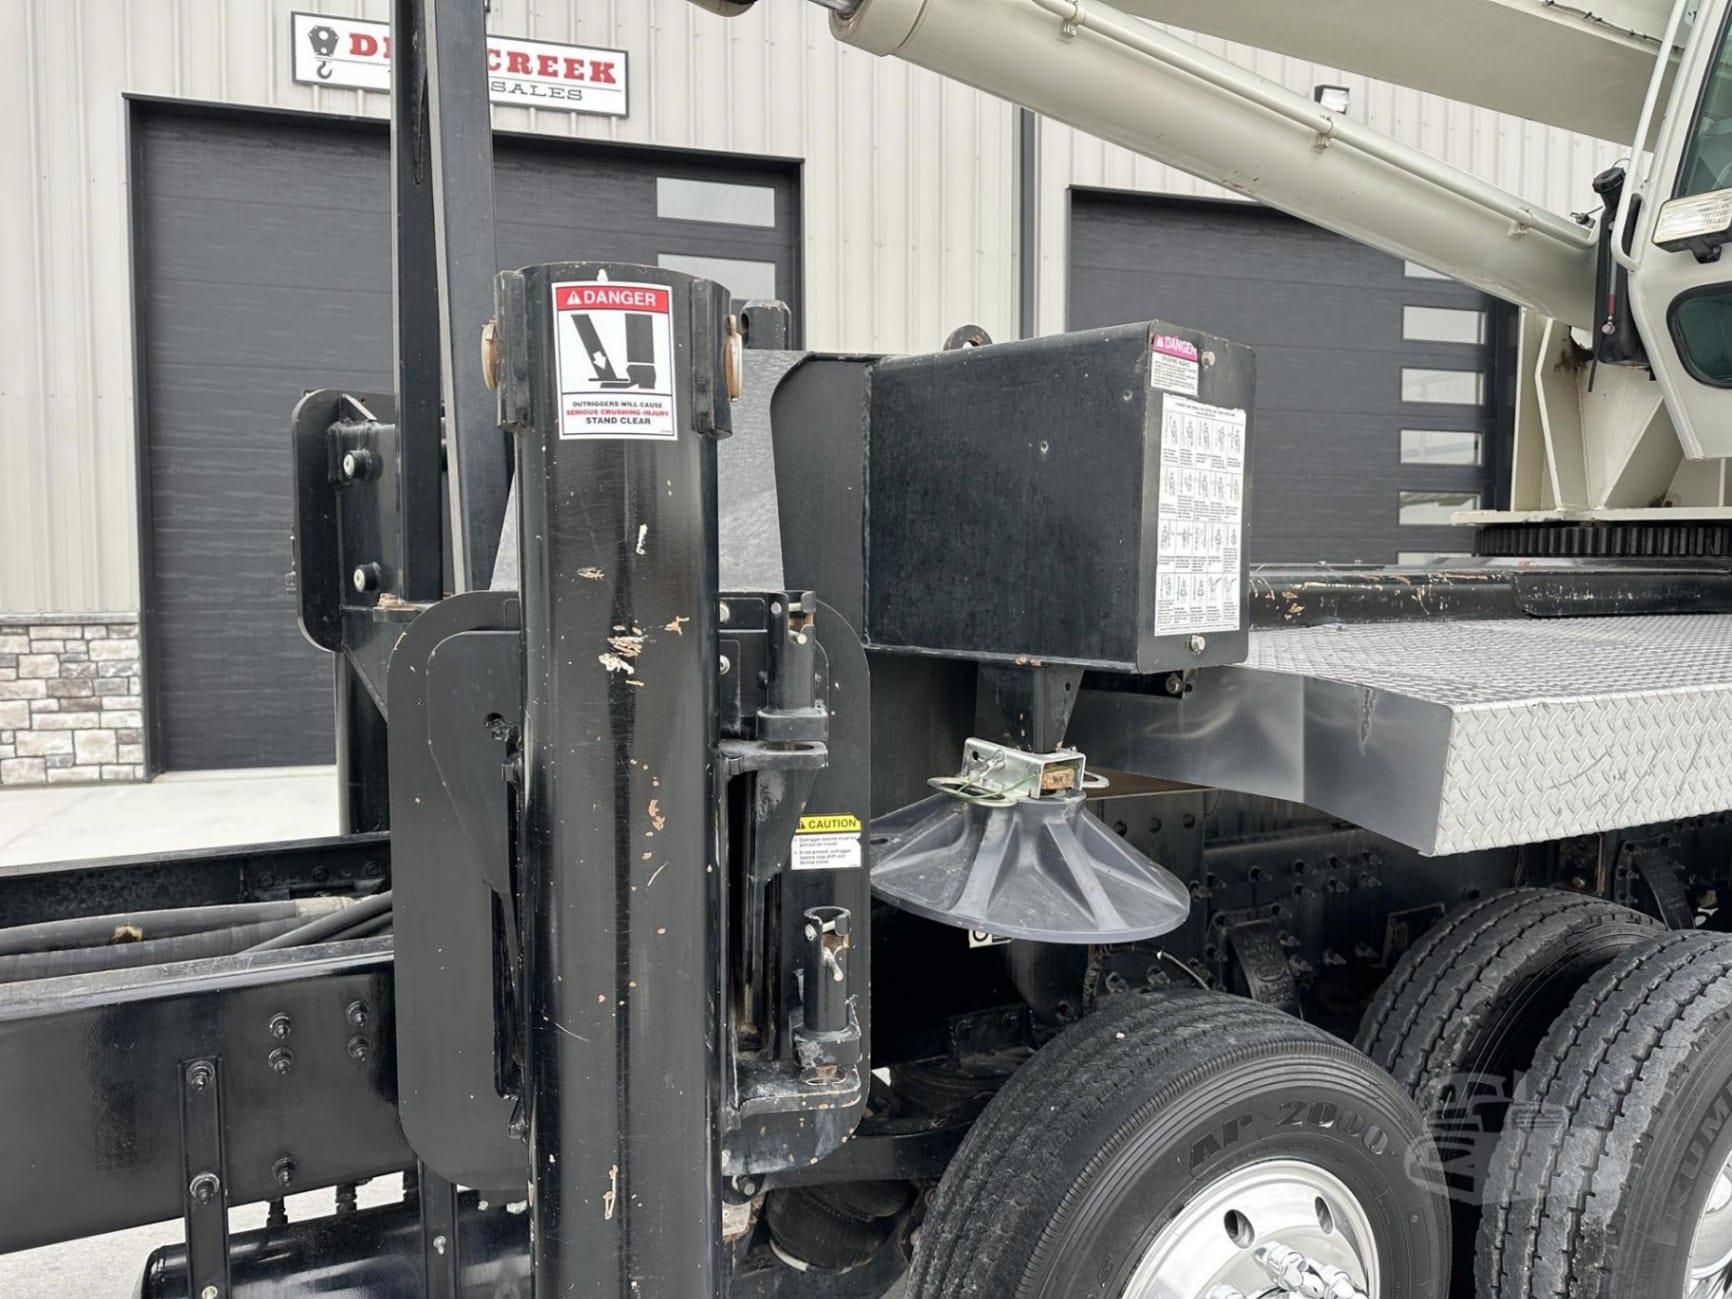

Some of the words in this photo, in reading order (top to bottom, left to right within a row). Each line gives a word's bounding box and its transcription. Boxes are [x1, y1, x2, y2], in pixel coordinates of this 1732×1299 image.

[487, 48, 616, 84] CREEK
[490, 81, 583, 101] SALES
[583, 290, 656, 307] DANGER
[643, 409, 669, 417] INJURY
[808, 819, 857, 829] CAUTION
[1188, 1115, 1254, 1170] AP
[1275, 1101, 1389, 1155] 2000
[1671, 1080, 1732, 1206] KUM
